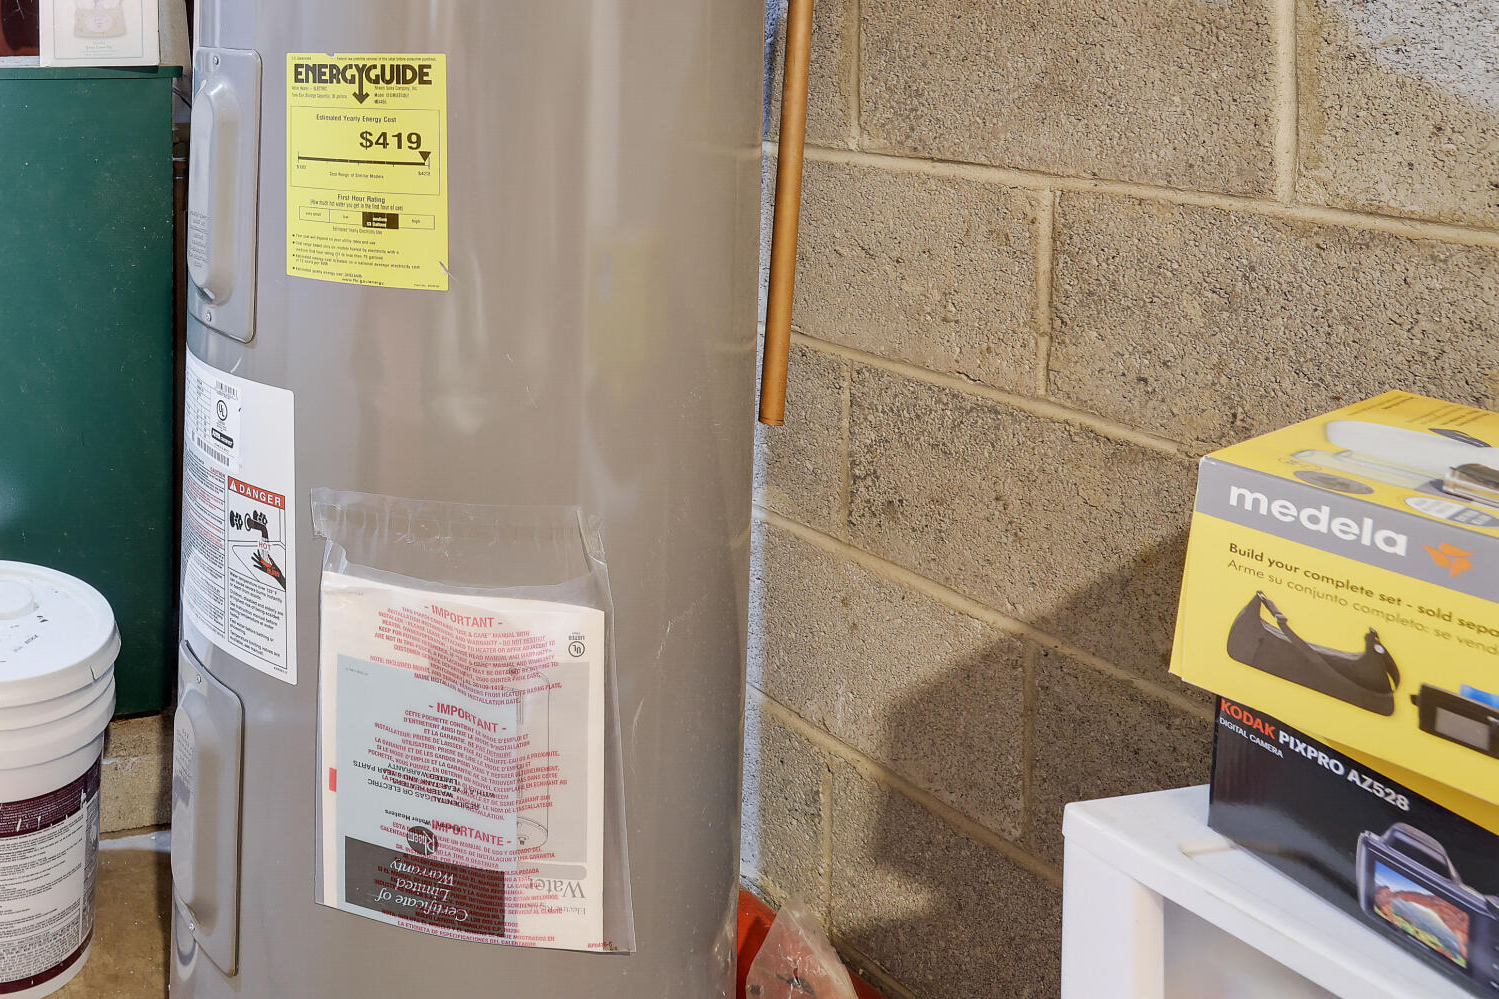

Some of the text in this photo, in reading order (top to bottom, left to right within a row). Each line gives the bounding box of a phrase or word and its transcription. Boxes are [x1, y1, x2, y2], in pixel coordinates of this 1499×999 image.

[294, 63, 432, 85] ENERGYGUIDE
[359, 131, 421, 150] $419
[352, 194, 365, 202] Hour
[367, 195, 386, 204] Rating
[240, 484, 282, 507] DANGER
[1229, 485, 1408, 556] medela
[259, 542, 271, 550] HOT
[1229, 542, 1264, 562] Build
[1268, 557, 1300, 575] your
[1304, 569, 1374, 598] complete
[1379, 591, 1402, 606] set
[1417, 602, 1452, 622] sold
[1227, 559, 1264, 579] Arme
[1268, 574, 1283, 585] su
[1287, 580, 1348, 607] conjunto
[1353, 601, 1429, 633] completo:
[1434, 628, 1451, 640] se
[431, 604, 495, 628] IMPORTANT
[437, 702, 499, 733] IMPORTANT
[1221, 698, 1276, 739] KODAK
[1220, 717, 1284, 759] DIGITAL CAMERA
[353, 760, 376, 771] PARTS
[387, 763, 428, 778] WARRANTY
[1279, 730, 1410, 812] PIXPRO AZ528
[368, 779, 401, 792] ELECTRIC
[384, 809, 411, 821] Heaters
[407, 830, 435, 856] Rheem
[431, 819, 505, 846] IMPORTANTE
[389, 858, 454, 886] Warranty
[396, 878, 451, 900] Limited
[374, 887, 469, 922] Certificate of
